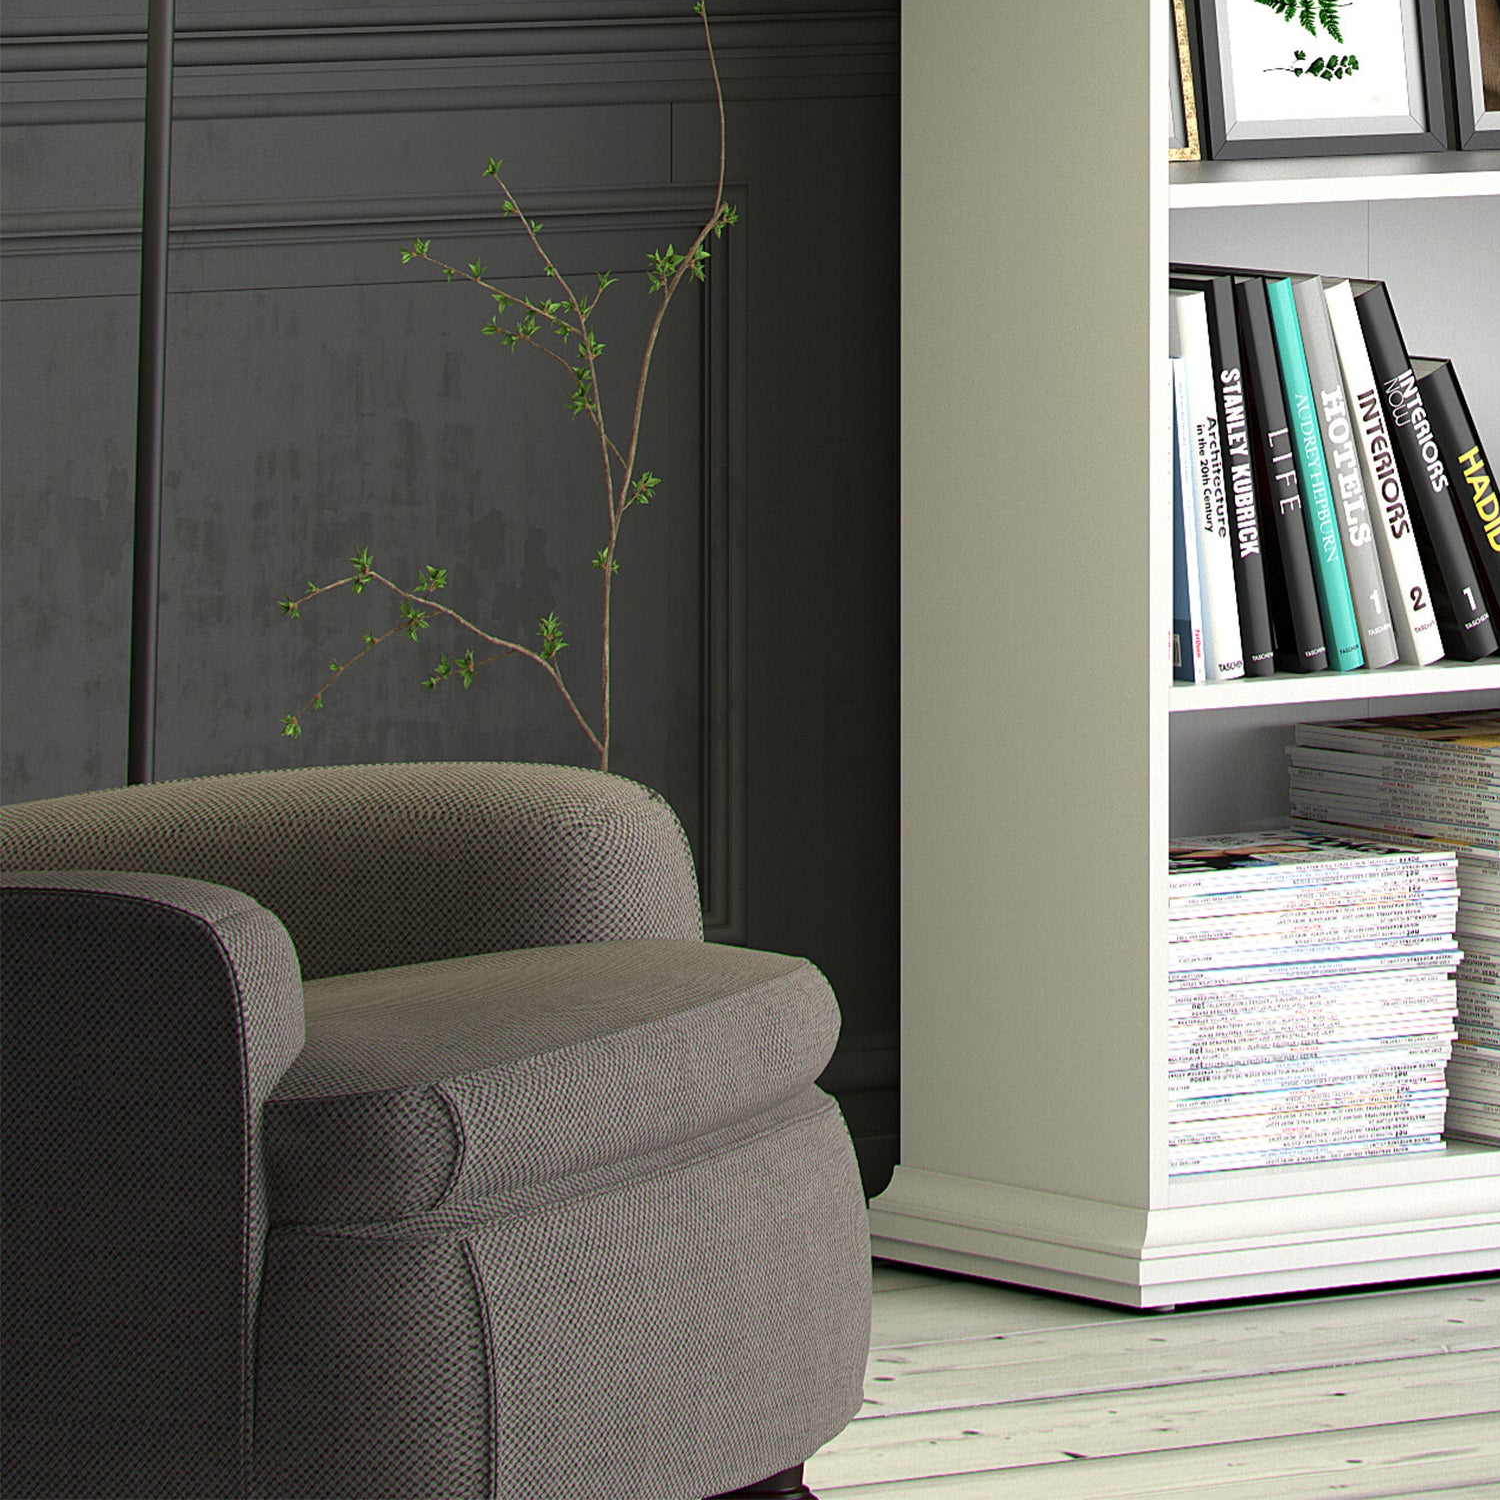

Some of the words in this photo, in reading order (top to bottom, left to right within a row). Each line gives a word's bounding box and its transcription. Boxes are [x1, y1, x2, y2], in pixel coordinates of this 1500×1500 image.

[1220, 367, 1249, 457] STANLEY
[1383, 377, 1411, 428] NOW
[1196, 423, 1205, 436] in
[1198, 438, 1207, 457] the
[1399, 368, 1449, 493] INTERIORS
[1200, 459, 1212, 486] 20th
[1206, 416, 1227, 539] Architecture
[1267, 427, 1302, 515] LIFE
[1295, 393, 1321, 469] AUDREY
[1310, 471, 1339, 563] HEPBURN
[1320, 386, 1372, 547] HOTELS
[1357, 389, 1411, 540] INTERIORS
[1204, 488, 1214, 533] Century
[1230, 465, 1260, 558] KUBRICK
[1369, 589, 1382, 614] 1
[1410, 586, 1426, 612] 2
[1463, 587, 1477, 612] 1
[1465, 614, 1490, 630] TASCHEN
[1368, 622, 1392, 636] TASCHEN
